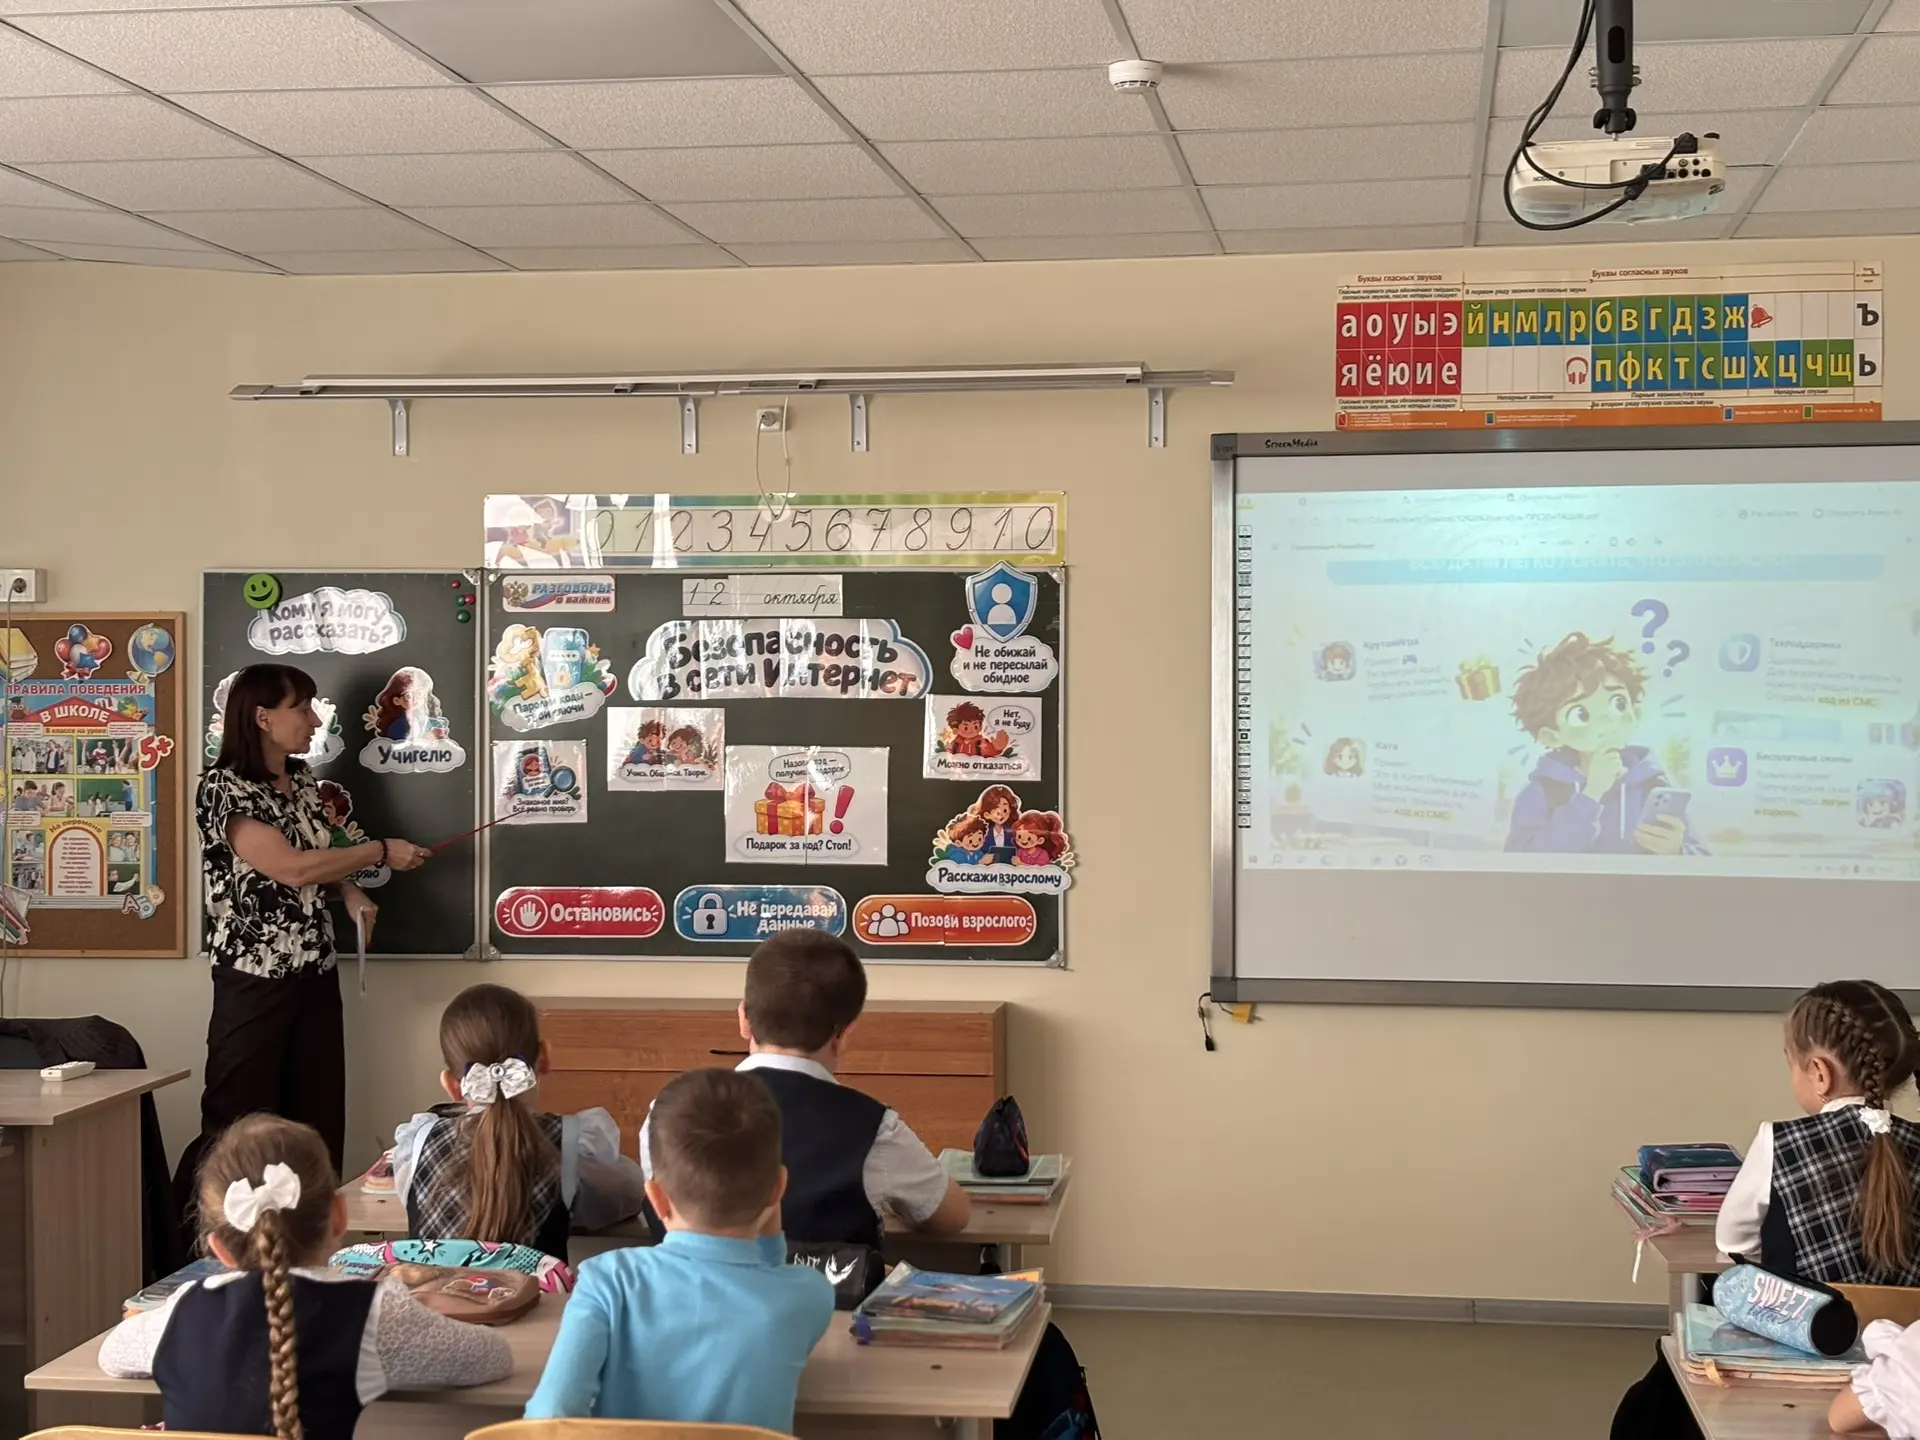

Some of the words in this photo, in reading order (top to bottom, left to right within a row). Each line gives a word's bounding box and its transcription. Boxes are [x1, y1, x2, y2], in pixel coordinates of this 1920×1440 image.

[1358, 275, 1382, 284] Буквы
[1384, 274, 1414, 282] гласных
[1417, 274, 1442, 282] звуков
[1592, 270, 1617, 279] Буквы
[1619, 268, 1660, 277] согласных
[1662, 268, 1688, 276] звуков
[1264, 438, 1318, 448] ScreenMedia
[635, 510, 653, 552] 1
[670, 510, 693, 551] 2
[707, 510, 733, 552] 3
[749, 510, 773, 552] 4
[785, 508, 813, 552] 5
[825, 508, 852, 552] 6
[866, 508, 892, 552] 7
[904, 508, 932, 551] 8
[946, 507, 973, 550] 9
[532, 583, 612, 594] РАЗГОВОРЫ
[565, 596, 611, 604] важном
[763, 584, 838, 613] октября
[336, 603, 388, 626] могу
[268, 623, 393, 646] рассказать?
[664, 631, 898, 670] Безопасность
[975, 645, 990, 658] Не
[994, 646, 1036, 658] обижай
[963, 661, 970, 670] и
[973, 661, 987, 670] не
[990, 659, 1048, 673] пересылай
[686, 664, 756, 693] сети
[764, 658, 917, 696] Интернет
[983, 672, 1030, 685] обидное
[6, 685, 65, 695] ПРАВИЛА
[70, 684, 146, 695] ПОВЕДЕНИЯ
[40, 711, 51, 723] В
[54, 705, 110, 723] ШКОЛЕ
[1003, 710, 1021, 719] Нет,
[1013, 719, 1031, 730] буду
[140, 736, 172, 769] 5+
[784, 758, 809, 768] Назов
[937, 759, 969, 769] Можно
[973, 761, 1022, 770] отказаться
[48, 824, 61, 833] На
[746, 838, 786, 852] Подарок
[790, 842, 799, 850] за
[802, 840, 823, 851] код?
[826, 839, 852, 850] Стоп!
[938, 867, 998, 884] Расскажи
[999, 873, 1062, 887] взрослому
[550, 902, 651, 922] Остановись
[737, 901, 756, 916] Не
[760, 902, 838, 918] передавай
[756, 918, 816, 933] данные
[911, 912, 959, 928] Позови
[963, 913, 1027, 932] взрослого
[1748, 1272, 1815, 1320] SWEET
